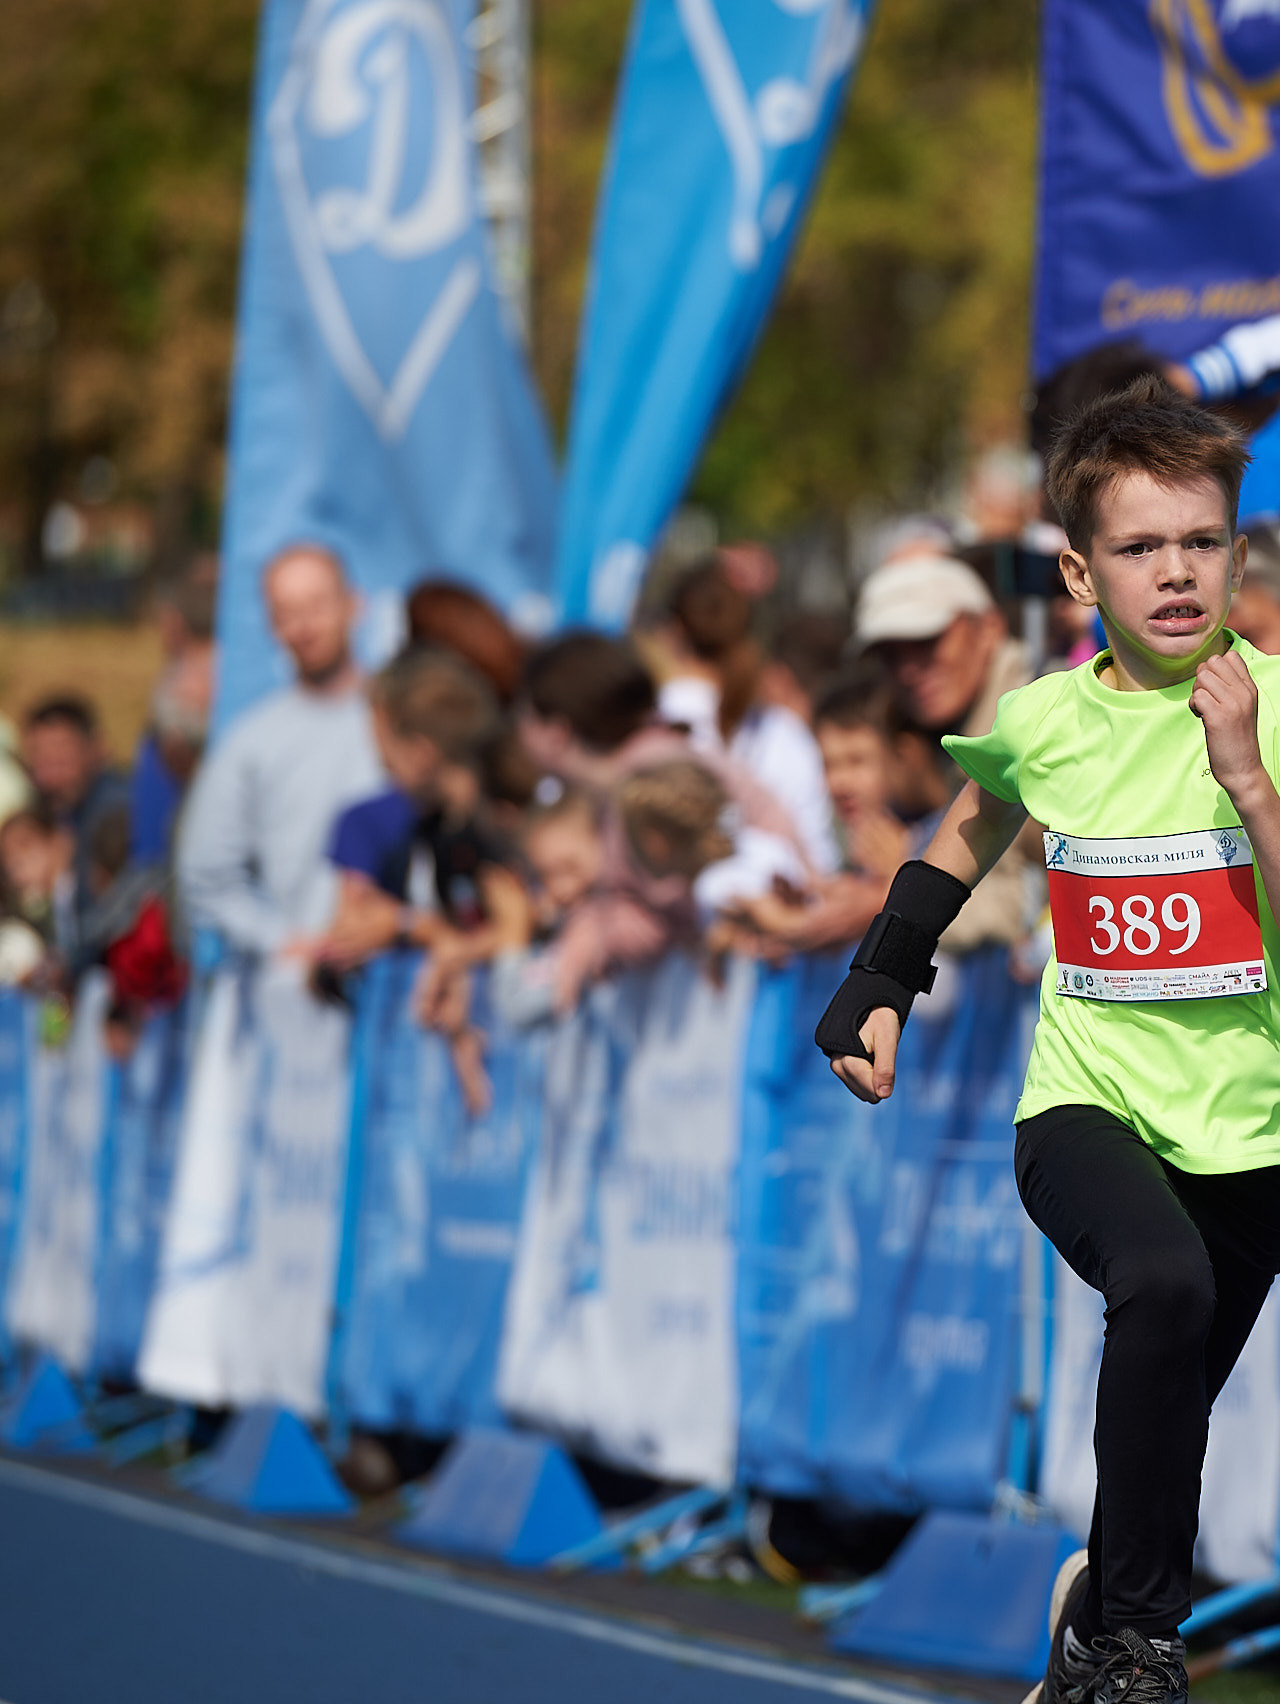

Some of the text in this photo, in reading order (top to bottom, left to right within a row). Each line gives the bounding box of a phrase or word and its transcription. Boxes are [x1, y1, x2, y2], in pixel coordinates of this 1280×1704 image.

[1072, 848, 1205, 866] Динамовская миля
[1088, 892, 1201, 956] 389
